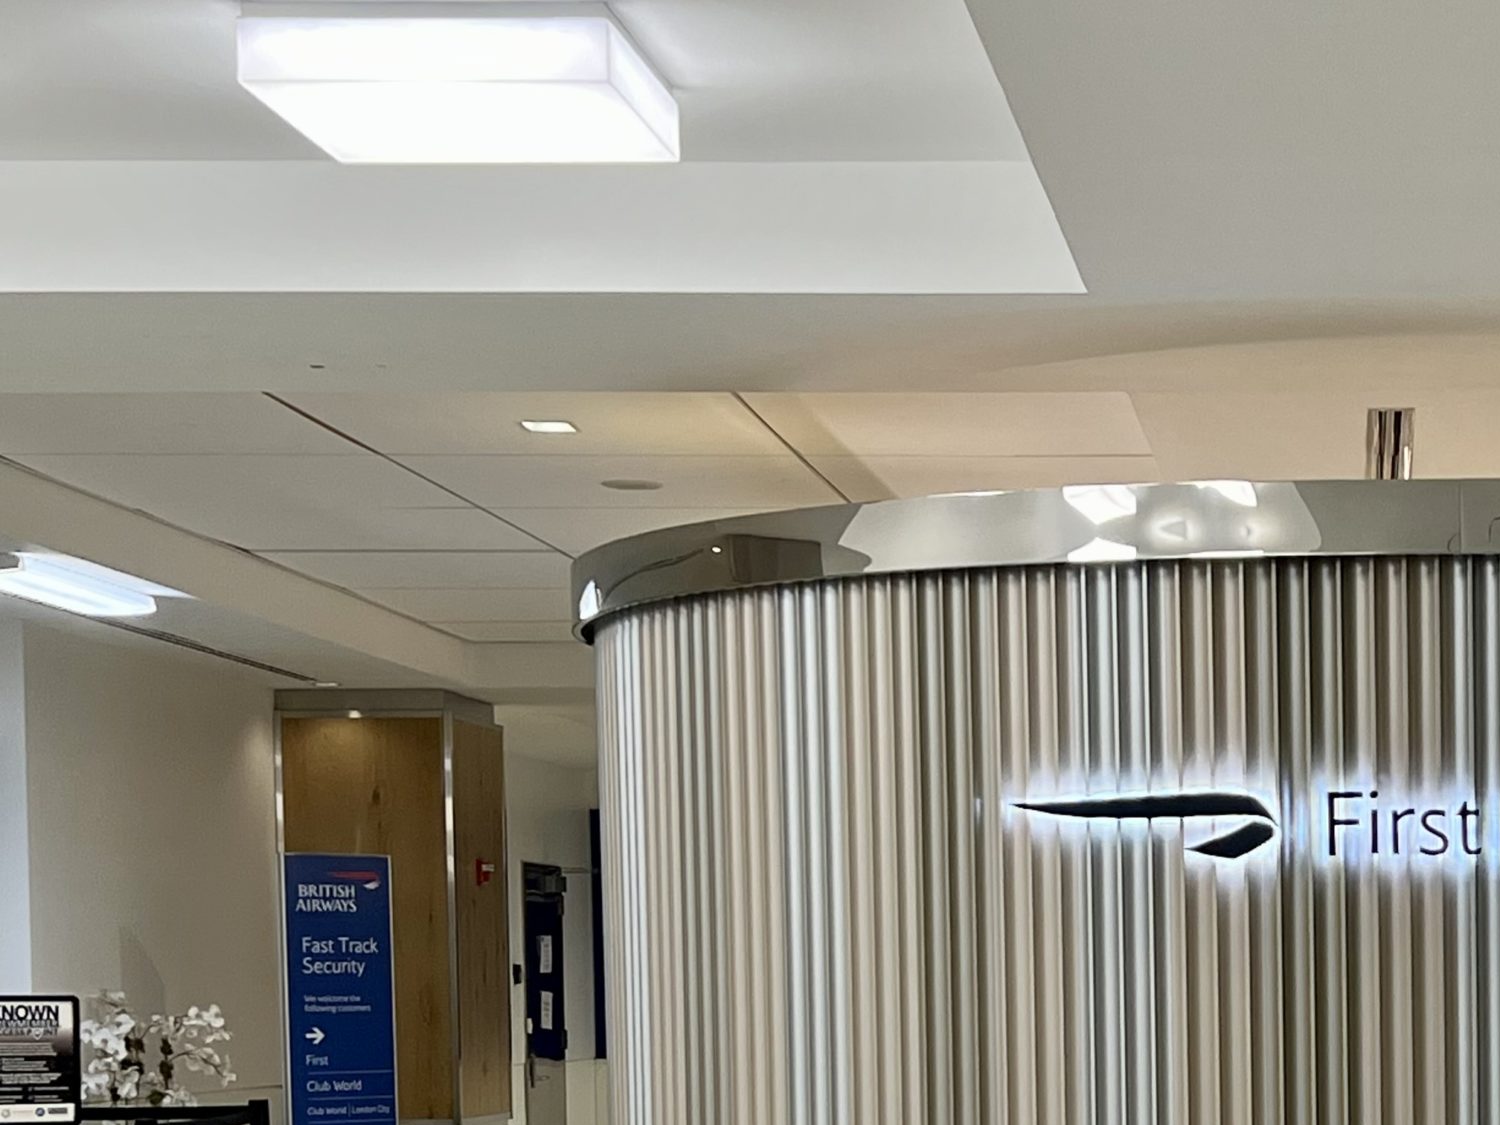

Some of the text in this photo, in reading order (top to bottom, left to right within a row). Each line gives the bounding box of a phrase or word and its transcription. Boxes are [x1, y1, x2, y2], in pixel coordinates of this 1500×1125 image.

[1327, 790, 1483, 856] First
[298, 884, 355, 897] BRITISH
[296, 899, 357, 912] AIRWAYS
[302, 937, 378, 953] Fast Track
[302, 957, 365, 977] Security
[0, 1005, 59, 1020] NOWN
[306, 1055, 328, 1066] First
[307, 1080, 362, 1092] Club World
[307, 1107, 324, 1115] Club
